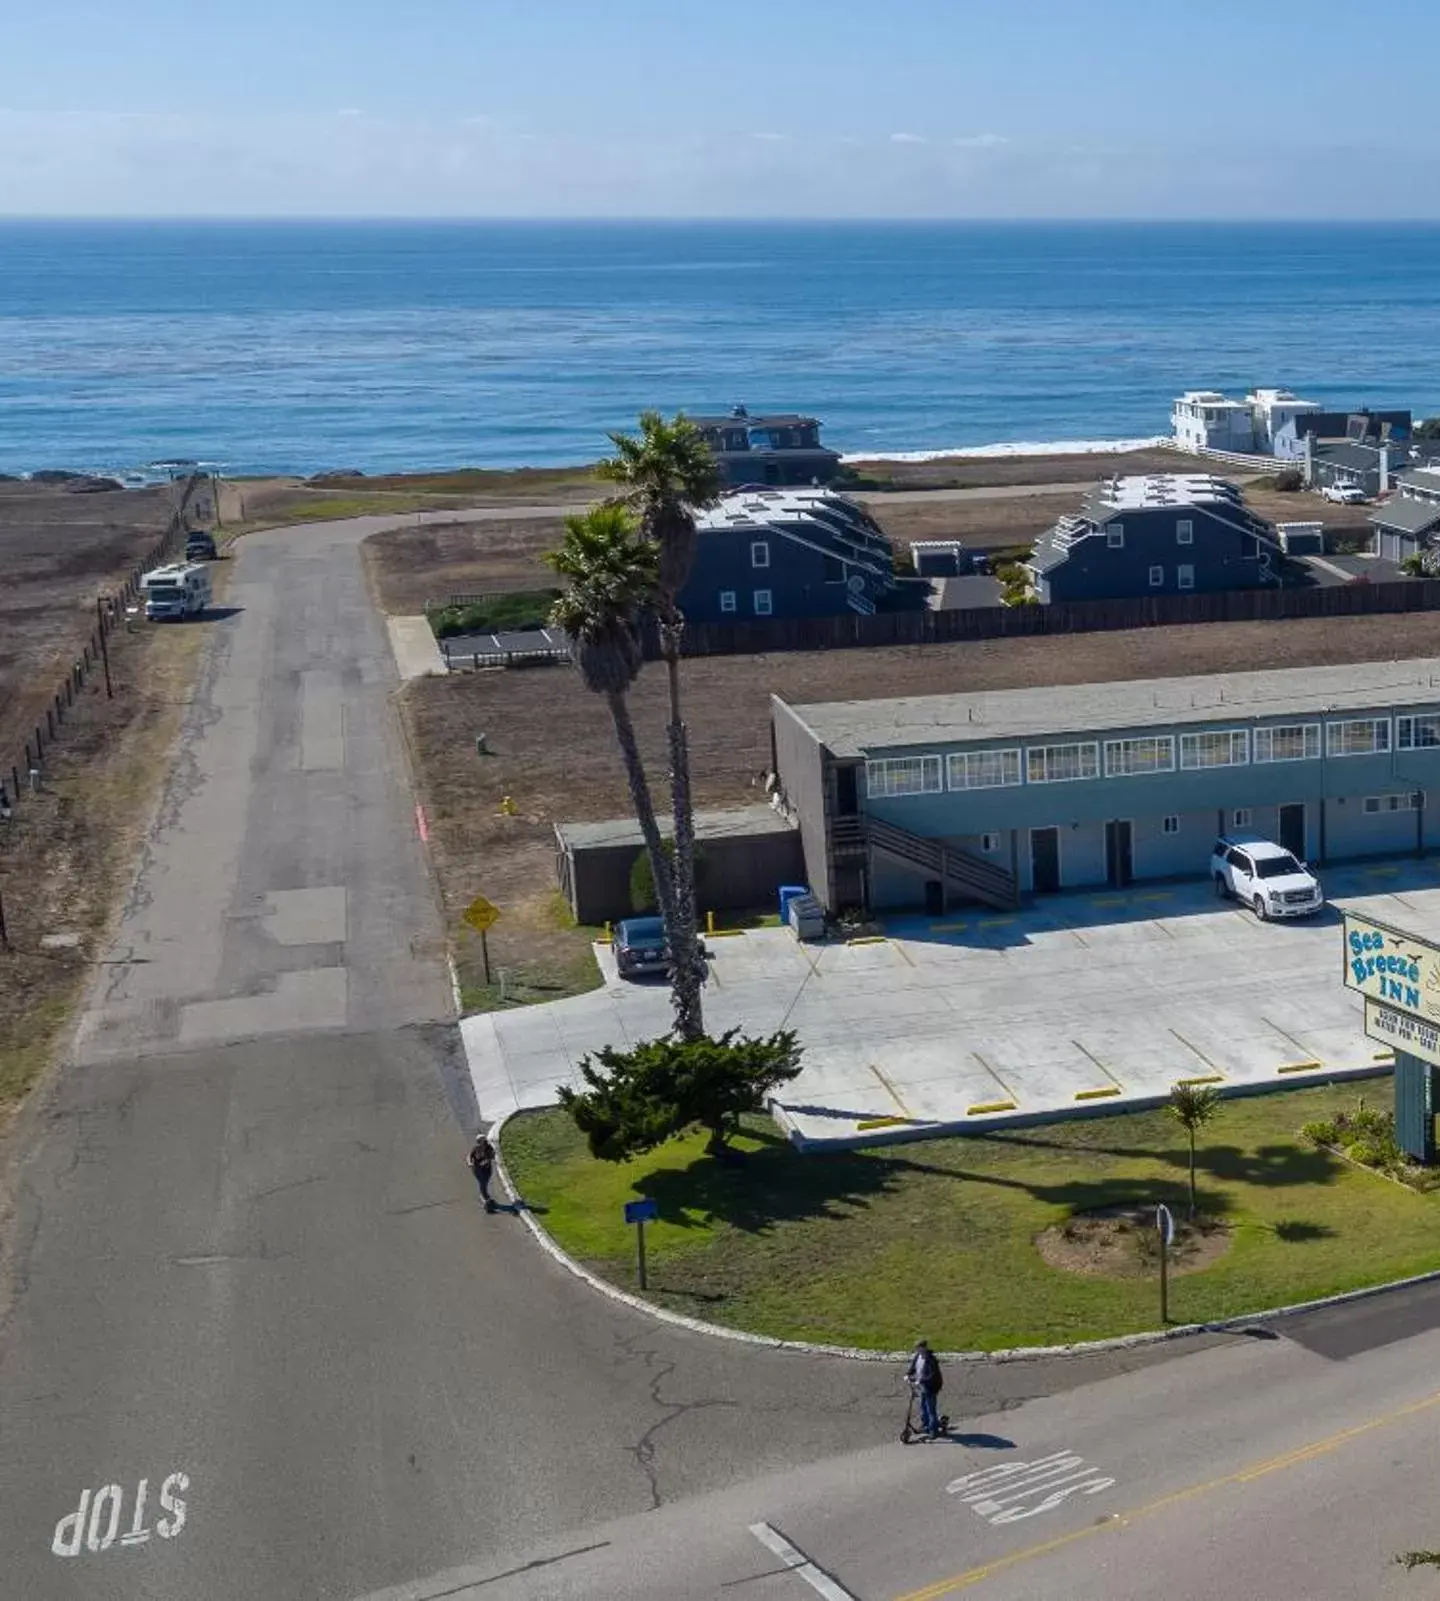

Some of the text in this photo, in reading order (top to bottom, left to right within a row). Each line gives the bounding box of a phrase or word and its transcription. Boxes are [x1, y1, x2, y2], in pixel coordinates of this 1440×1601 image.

[1349, 930, 1384, 956] Sea
[1351, 955, 1419, 985] Breeze
[1380, 975, 1420, 1009] INN
[51, 1472, 190, 1557] STOP
